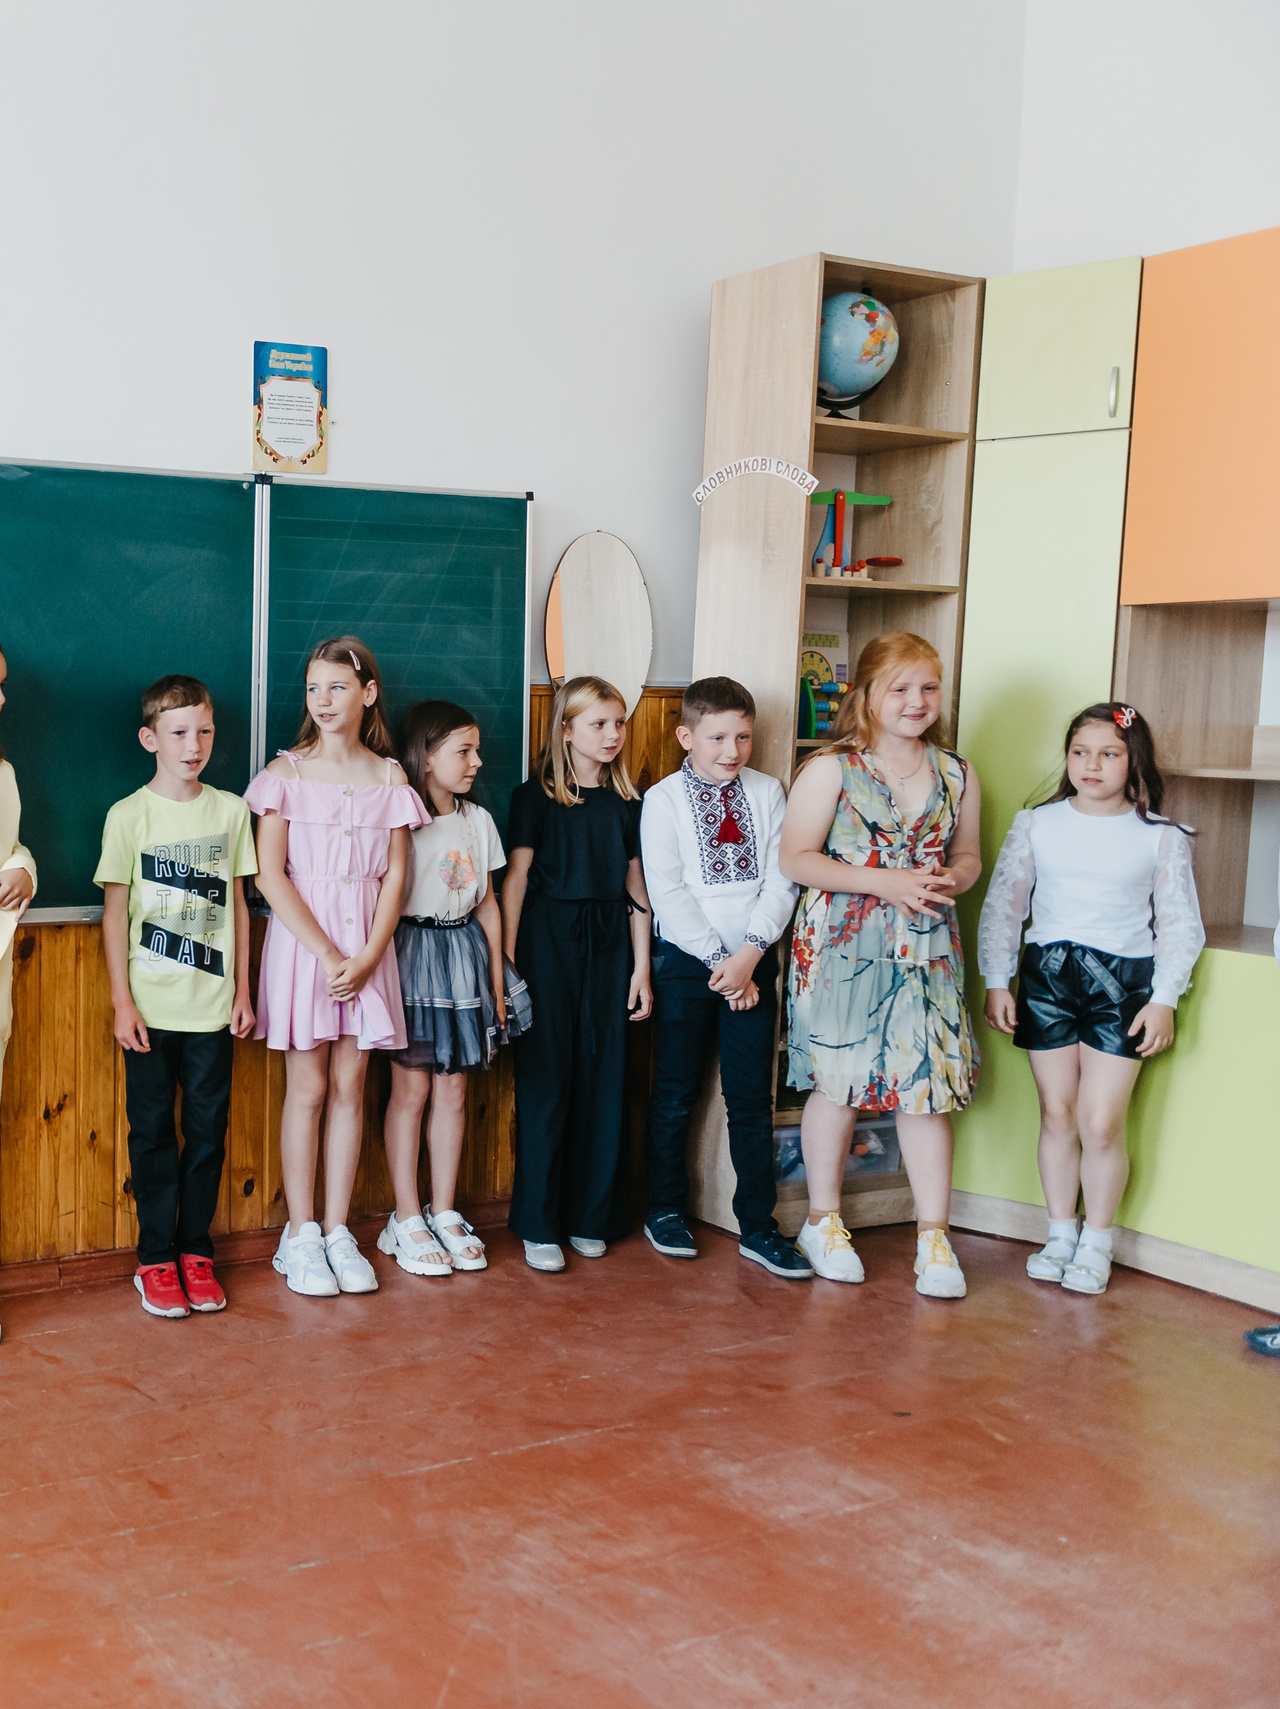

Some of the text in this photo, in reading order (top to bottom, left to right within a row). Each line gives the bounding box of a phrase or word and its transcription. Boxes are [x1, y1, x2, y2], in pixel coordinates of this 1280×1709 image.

[694, 457, 816, 503] СЛОВНИКОВІ СЛОВА
[154, 844, 222, 878] RULE
[156, 888, 219, 921] THE
[149, 930, 215, 965] DAY
